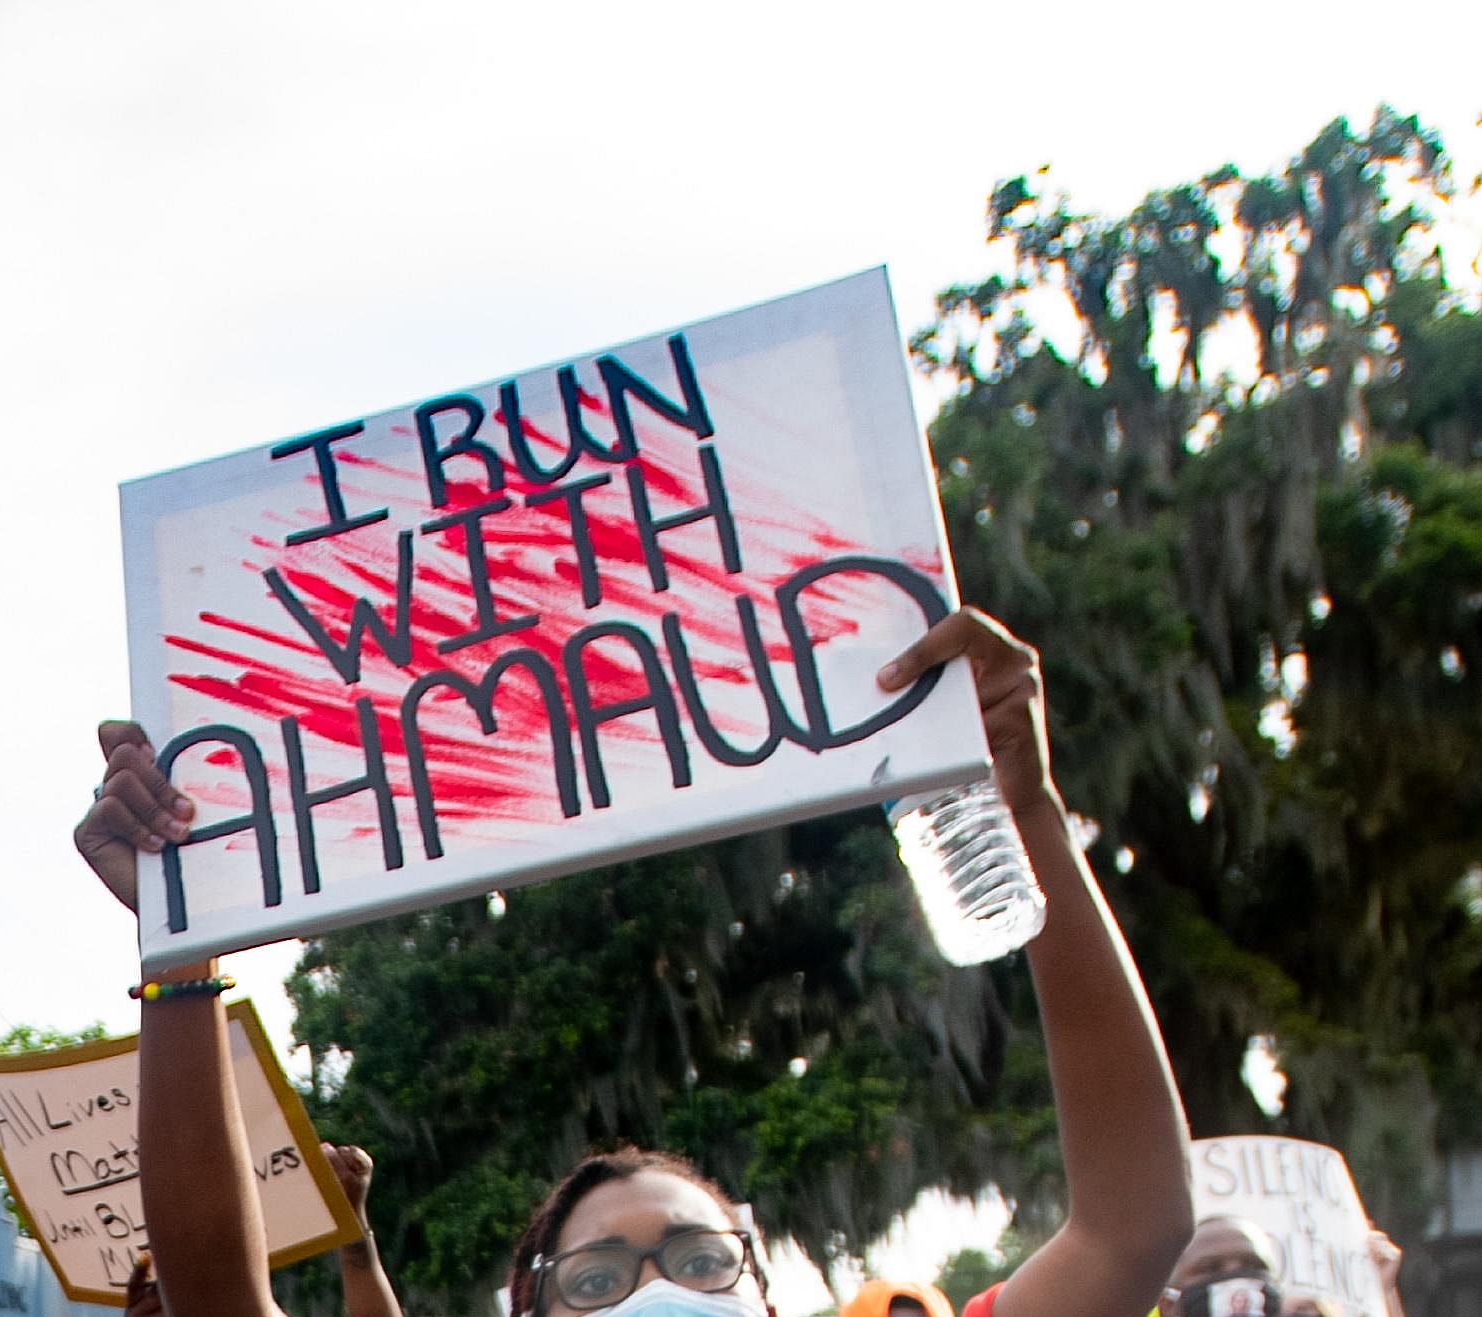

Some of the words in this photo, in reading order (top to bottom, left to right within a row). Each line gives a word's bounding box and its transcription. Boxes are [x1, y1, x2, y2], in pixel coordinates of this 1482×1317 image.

[271, 419, 388, 547] I
[414, 332, 715, 508] RUN
[262, 444, 741, 684] WITH
[156, 556, 951, 934] AHMAUD
[38, 1088, 131, 1130] Lives
